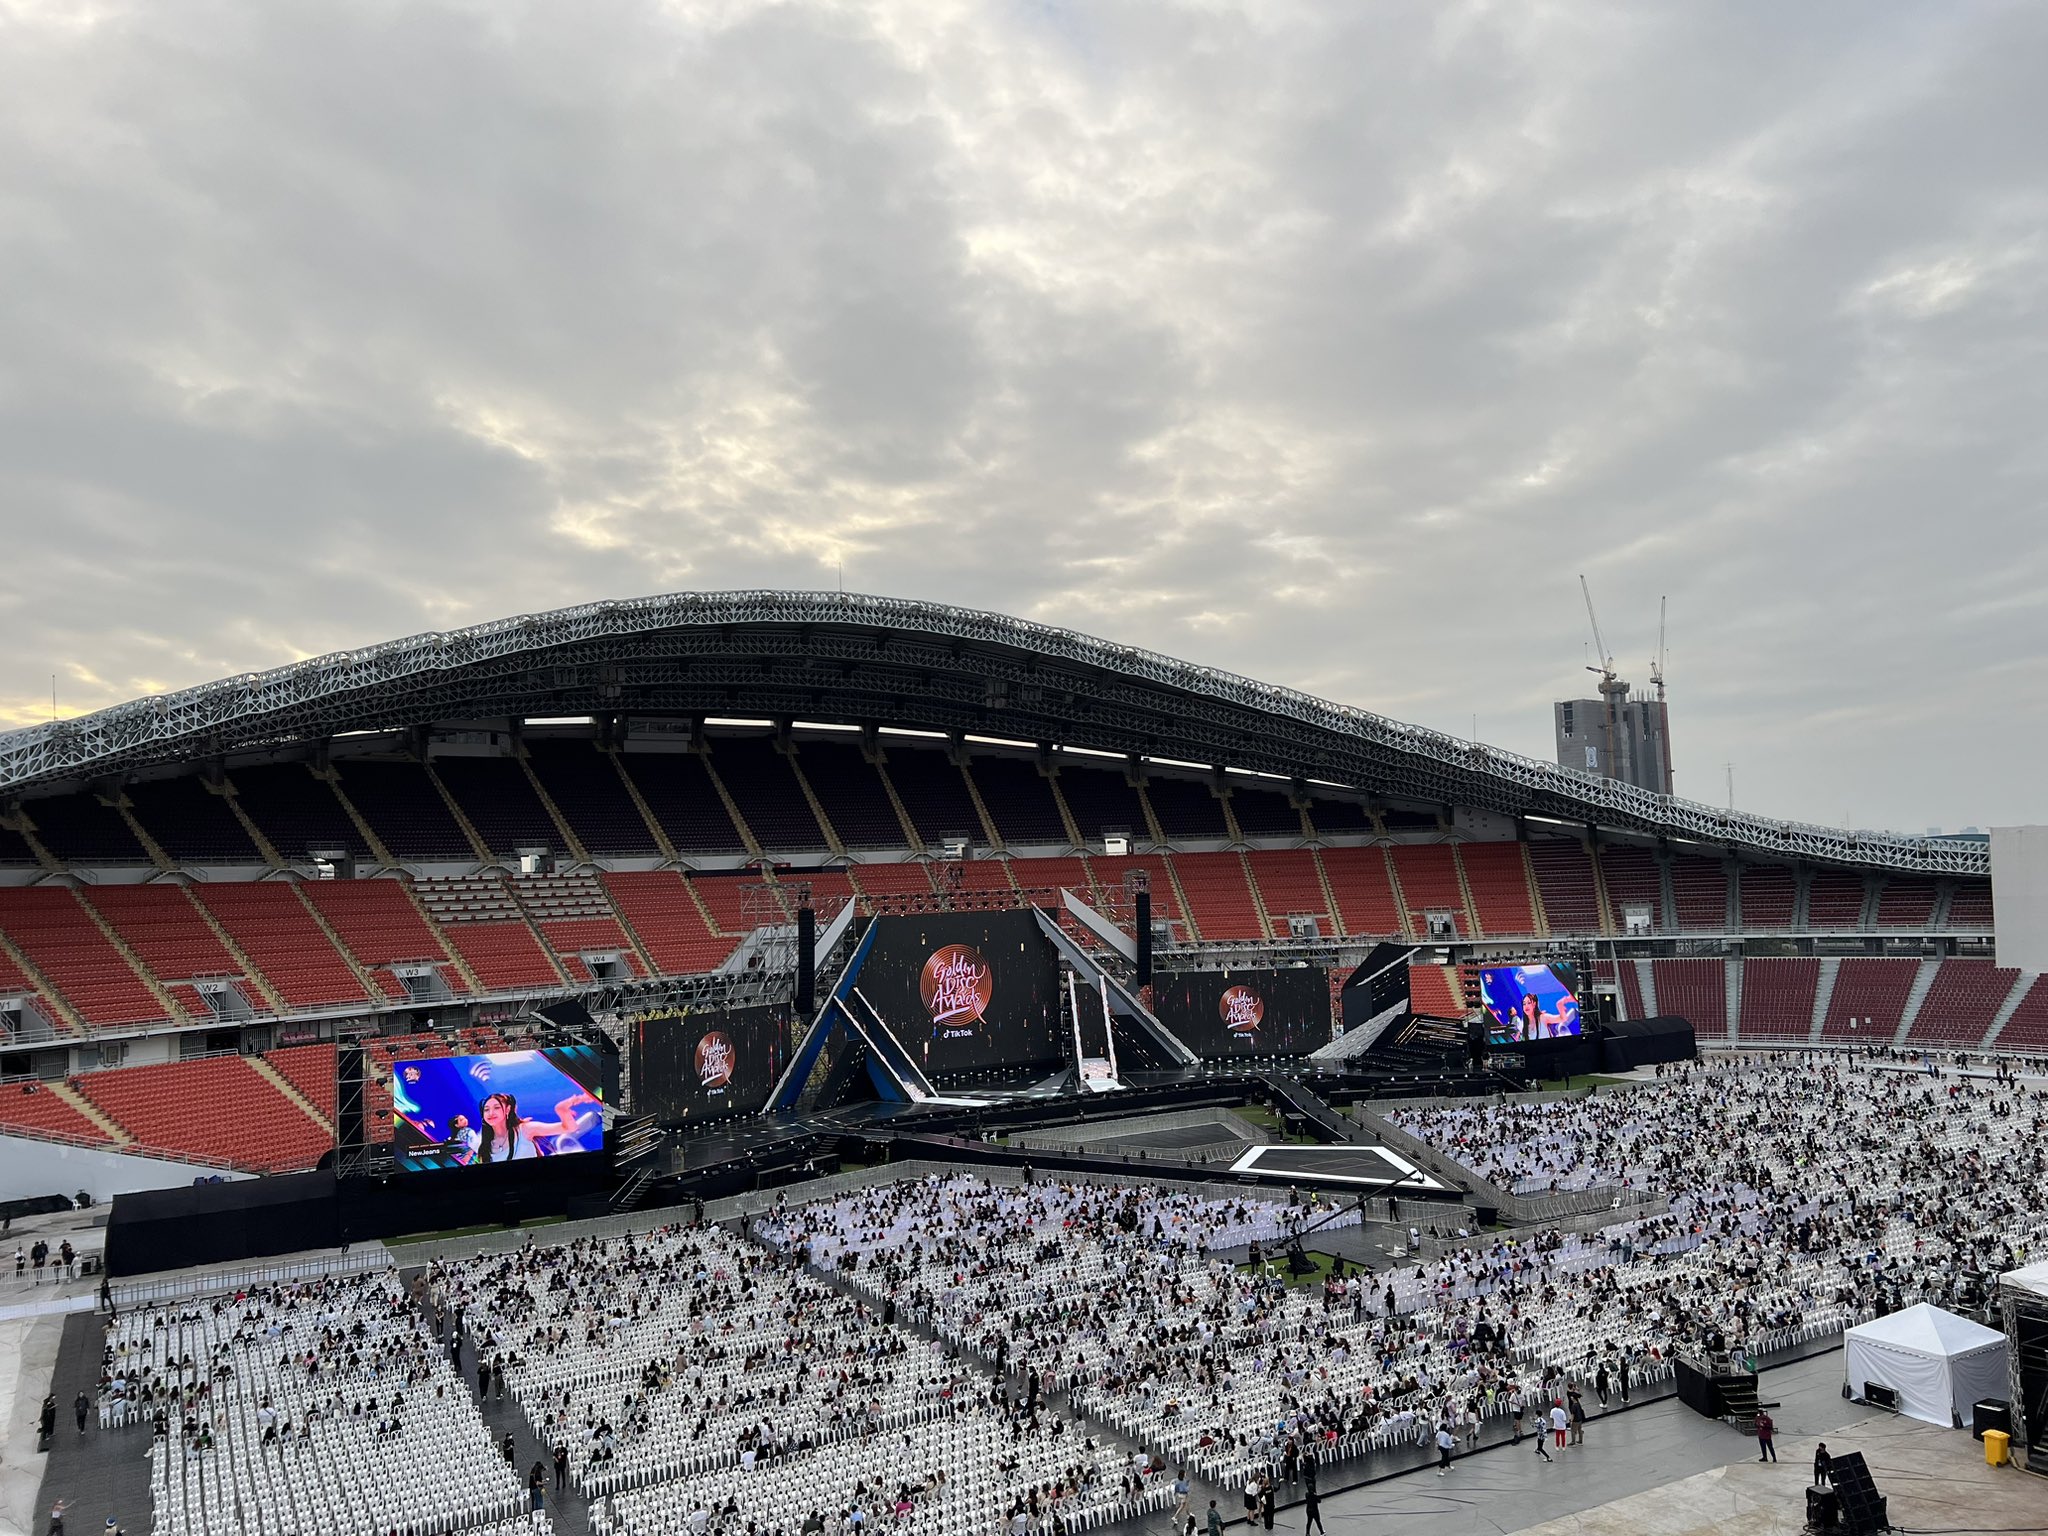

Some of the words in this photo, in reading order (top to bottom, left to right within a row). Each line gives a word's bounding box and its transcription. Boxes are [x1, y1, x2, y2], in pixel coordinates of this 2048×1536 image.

[933, 952, 986, 983] Golden
[405, 968, 419, 976] W3
[203, 984, 218, 992] W2
[931, 984, 985, 1018] Awards
[951, 1029, 973, 1038] TikTok
[408, 1149, 441, 1157] NewJeans
